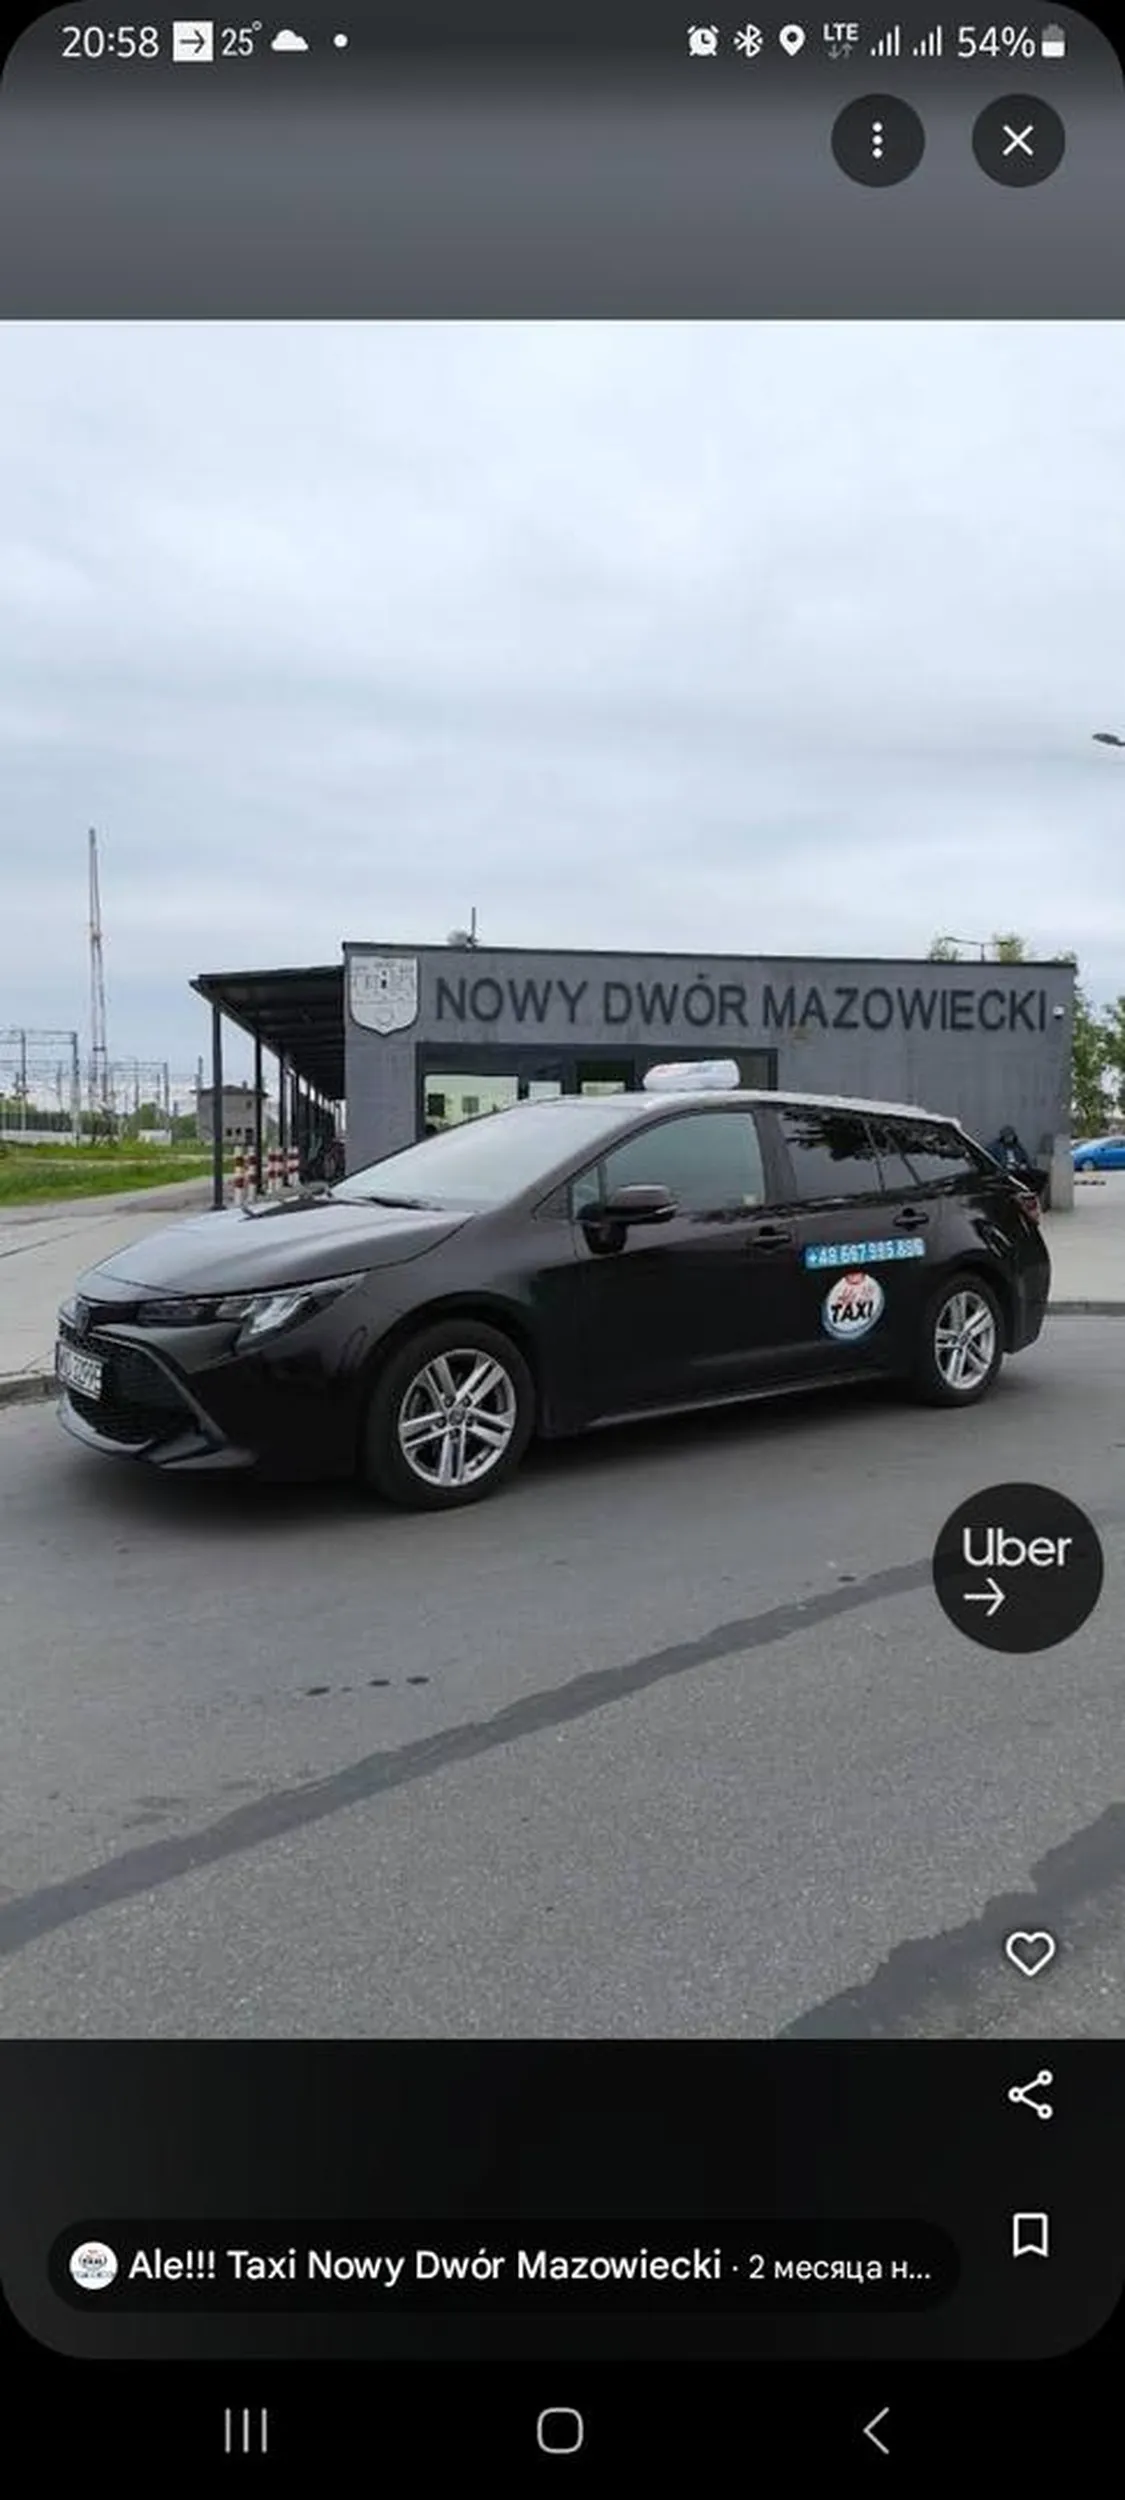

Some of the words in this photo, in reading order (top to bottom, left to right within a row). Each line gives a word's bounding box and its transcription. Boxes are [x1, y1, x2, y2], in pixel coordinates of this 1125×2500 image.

[435, 977, 588, 1024] NOWY
[603, 974, 748, 1027] DWÓR
[762, 985, 1047, 1032] MAZOWIECKI
[831, 1301, 874, 1323] TAXI
